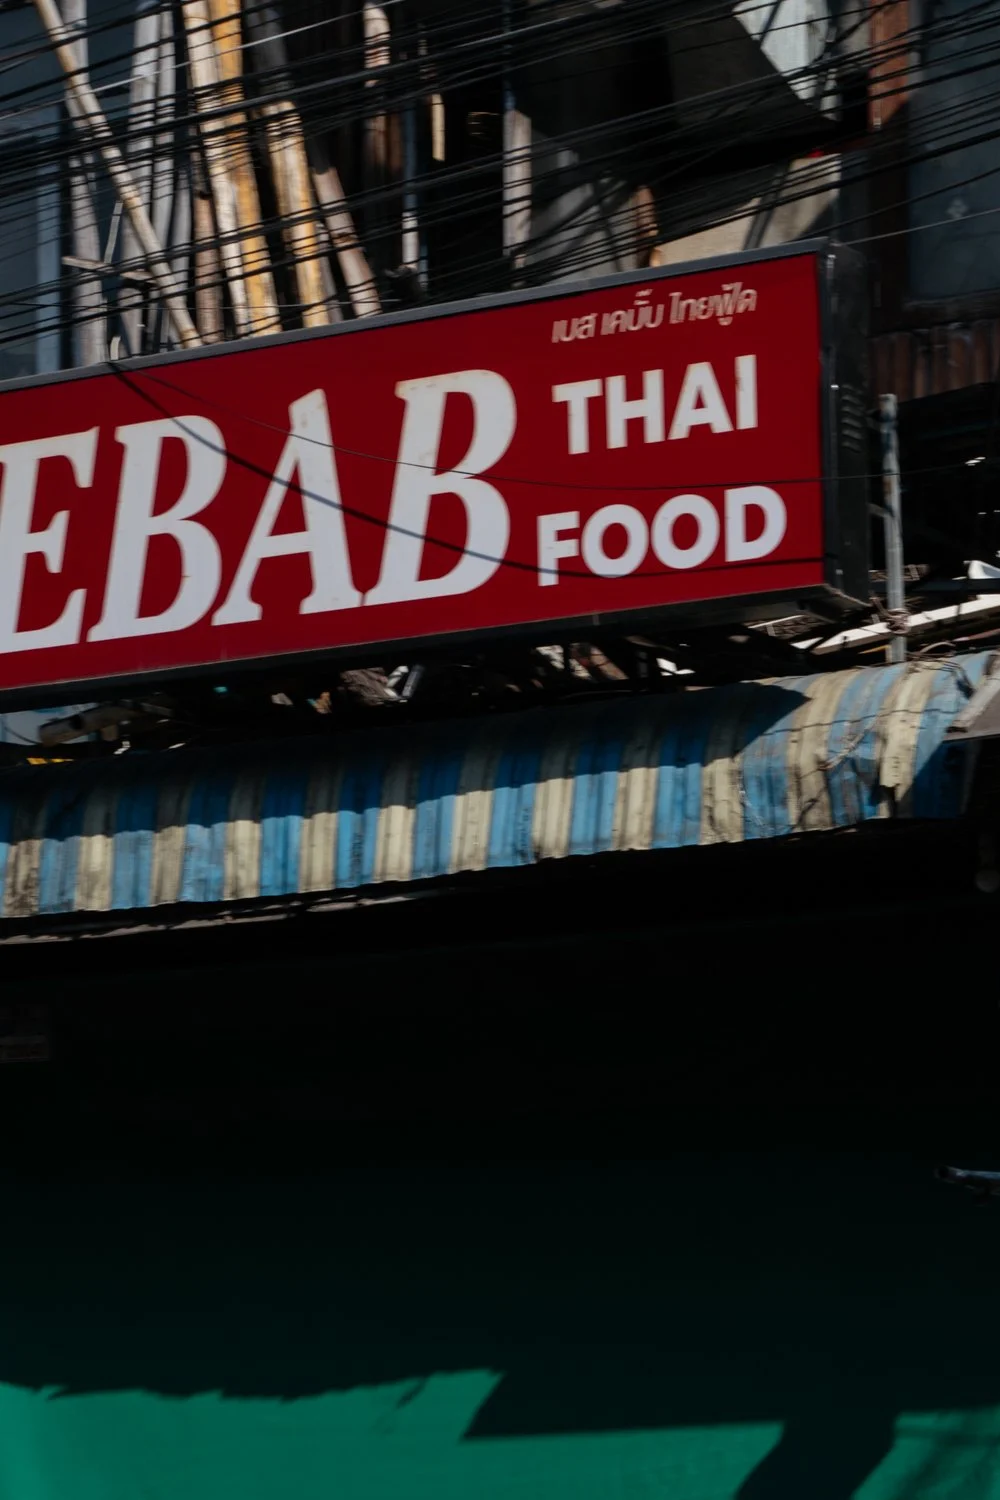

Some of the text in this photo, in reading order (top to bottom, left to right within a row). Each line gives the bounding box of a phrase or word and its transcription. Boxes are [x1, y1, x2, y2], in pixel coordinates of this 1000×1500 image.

[552, 354, 759, 455] THAI
[0, 368, 517, 653] EBAB
[536, 485, 788, 587] FOOD
